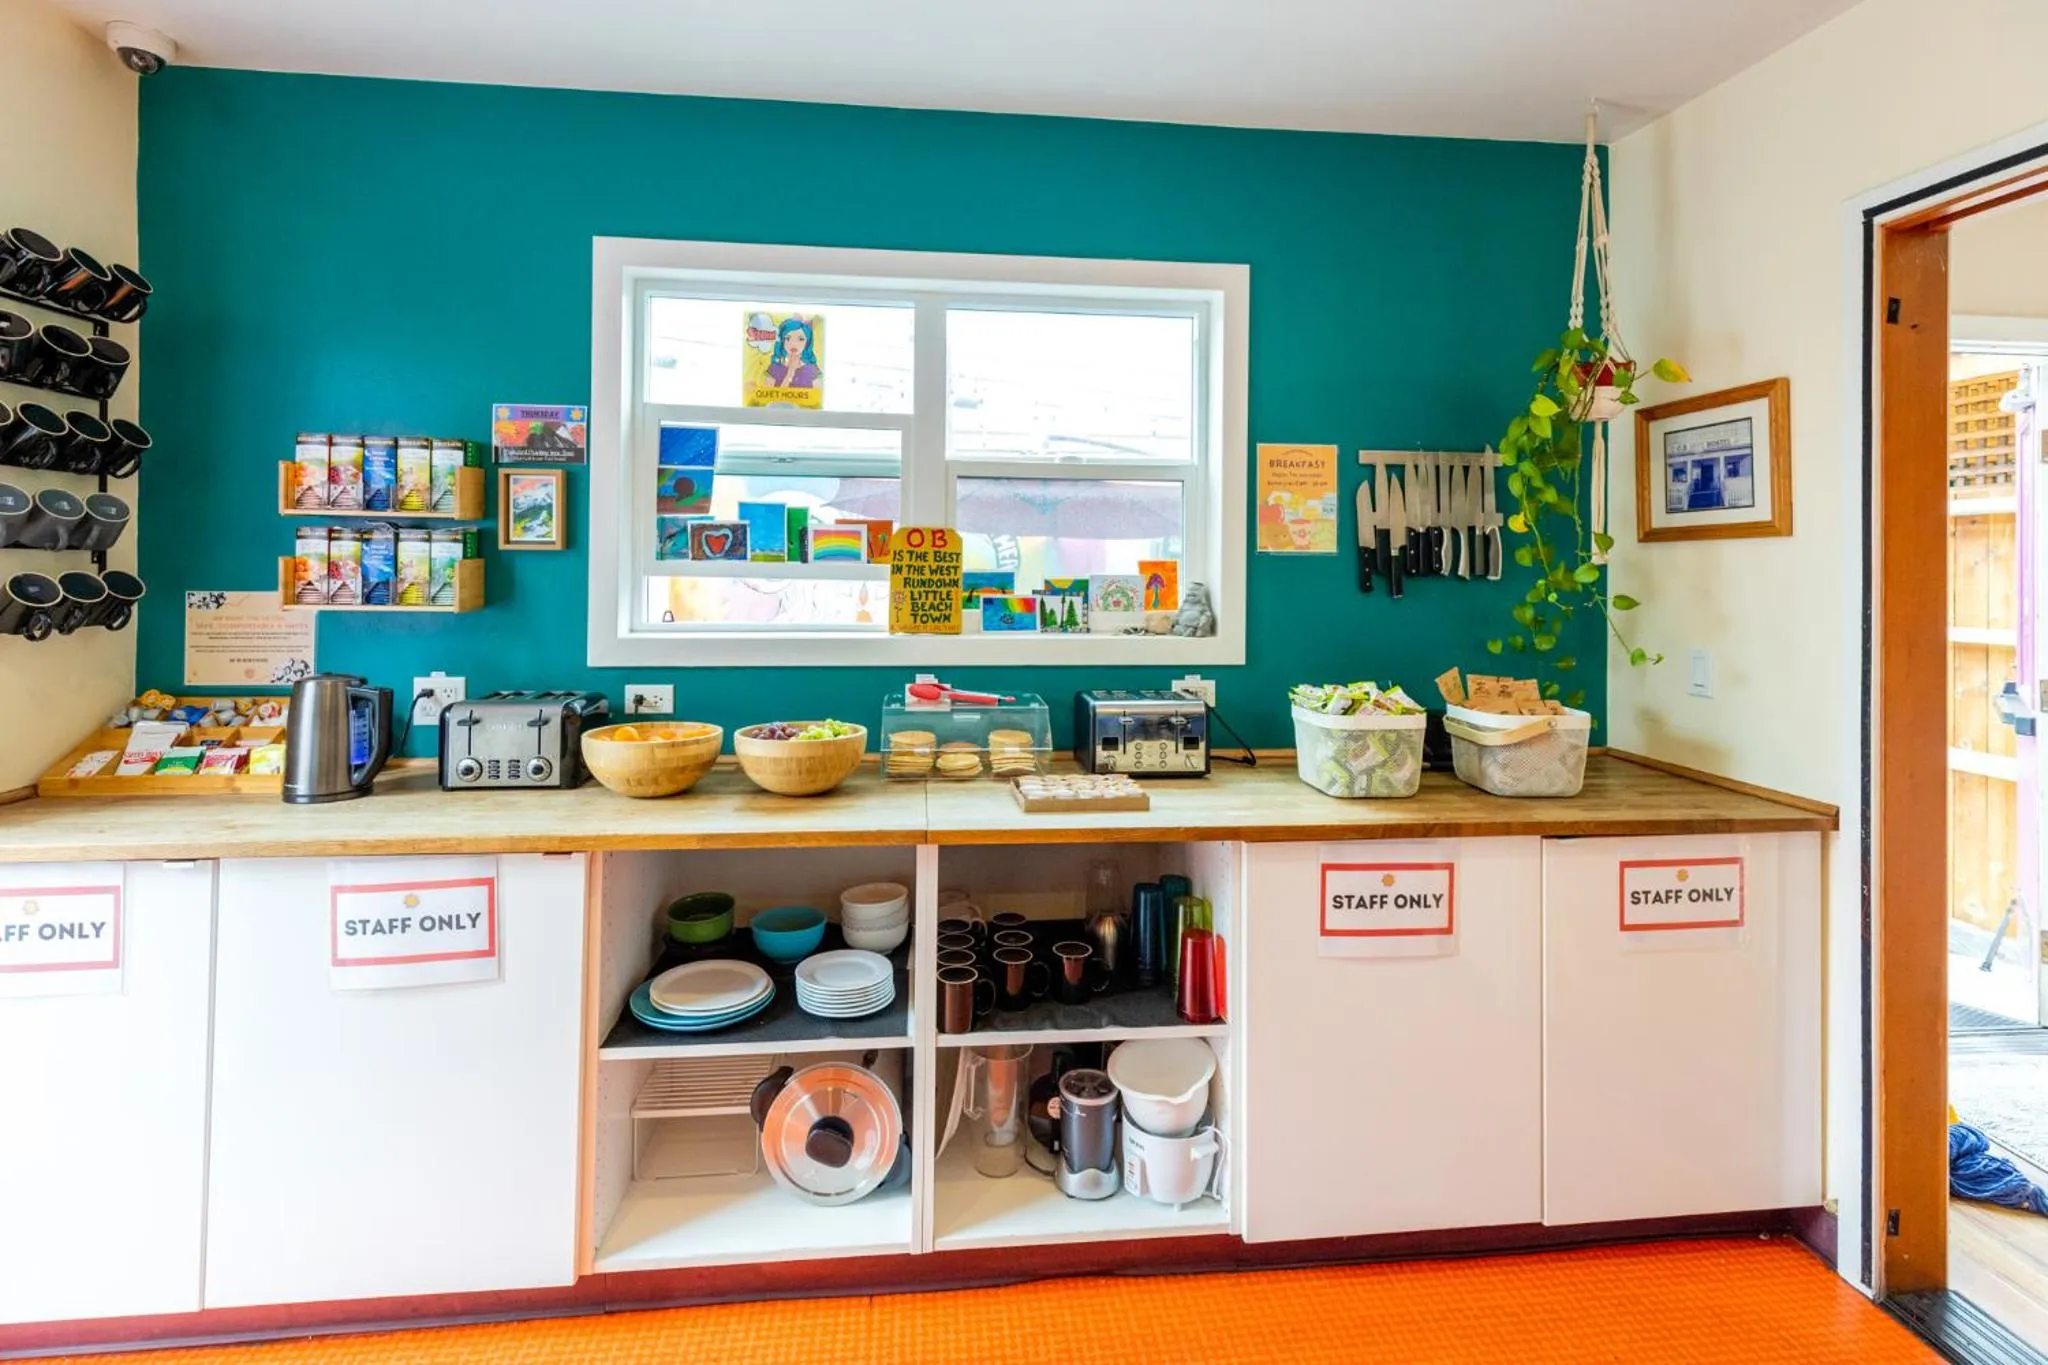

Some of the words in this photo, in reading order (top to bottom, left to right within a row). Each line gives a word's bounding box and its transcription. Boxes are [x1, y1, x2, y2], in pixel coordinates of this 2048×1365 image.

[756, 389, 780, 399] QUIET
[781, 391, 809, 400] HOURS
[1268, 459, 1327, 469] BREAKFAST
[893, 550, 904, 562] IS
[906, 550, 929, 562] THE
[933, 550, 962, 563] BEST
[891, 563, 903, 576] IN
[905, 564, 926, 576] THE
[928, 564, 960, 576] WEST
[903, 577, 960, 589] RUNDOWN
[910, 590, 953, 601] LITTLE
[911, 601, 953, 613] BEACH
[910, 613, 951, 625] TOWN
[1332, 893, 1389, 910] STAFF
[1393, 892, 1444, 909] ONLY
[1630, 888, 1683, 905] STAFF
[1687, 886, 1735, 903] ONLY
[344, 916, 412, 937] STAFF
[418, 911, 482, 932] ONLY
[0, 923, 31, 943] FF
[37, 920, 107, 941] ONLY
